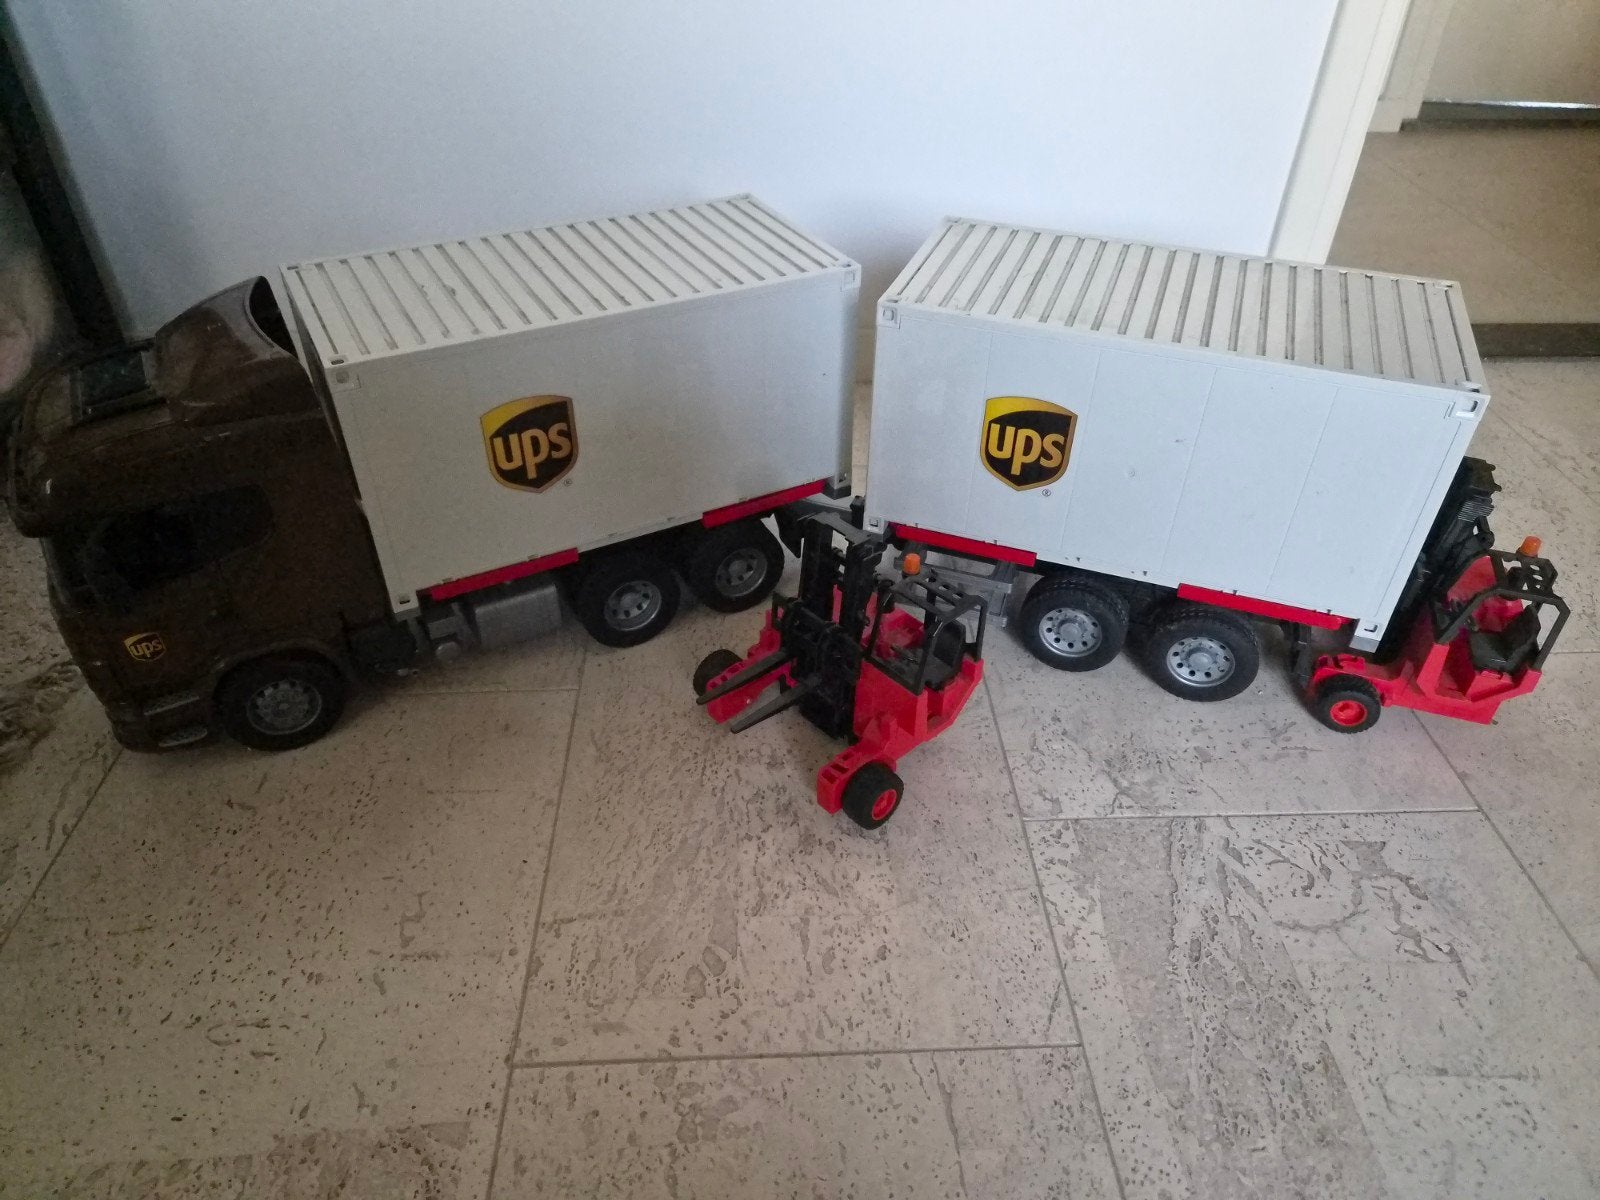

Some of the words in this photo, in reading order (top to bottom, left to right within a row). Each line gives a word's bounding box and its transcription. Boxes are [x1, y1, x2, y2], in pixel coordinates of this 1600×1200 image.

[493, 422, 572, 480] ups
[988, 423, 1065, 476] ups
[130, 639, 162, 657] ups
